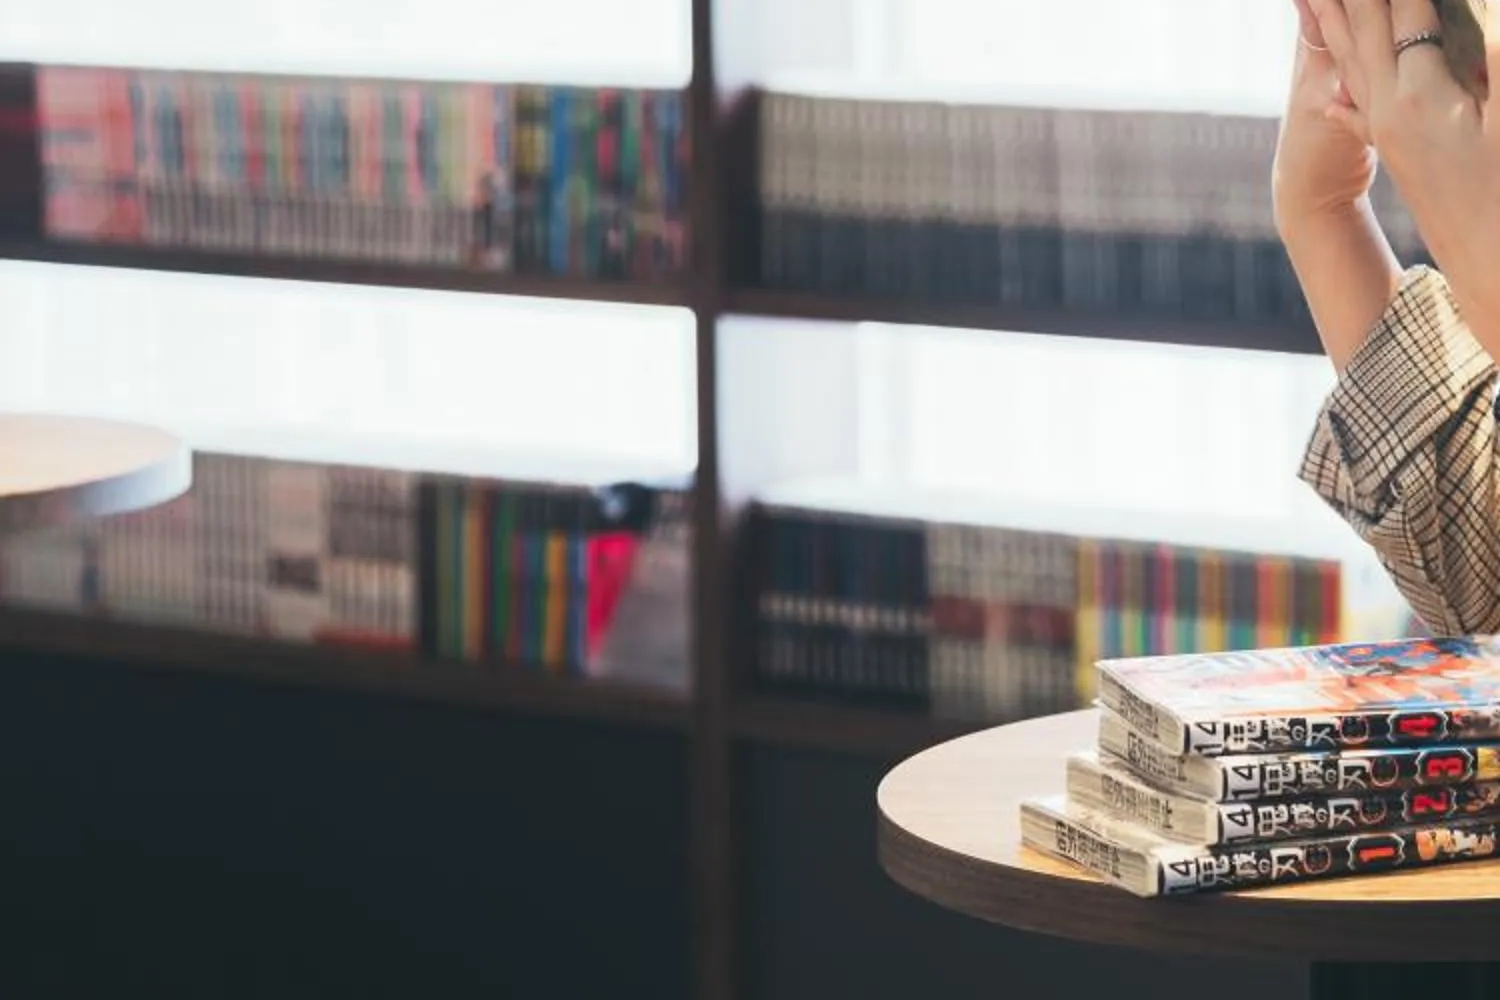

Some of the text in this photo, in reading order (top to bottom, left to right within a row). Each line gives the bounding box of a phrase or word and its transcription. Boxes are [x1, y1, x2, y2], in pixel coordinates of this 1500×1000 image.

[1193, 720, 1223, 751] 14
[1228, 715, 1439, 750] 鬼滅の刃 4
[1231, 764, 1259, 797] 14
[1264, 756, 1464, 796] 鬼滅の刃 3
[1226, 807, 1252, 842] 14
[1258, 791, 1449, 837] 鬼滅の刃 2
[1169, 859, 1198, 891] 14
[1198, 846, 1396, 887] 鬼滅の刃 1
